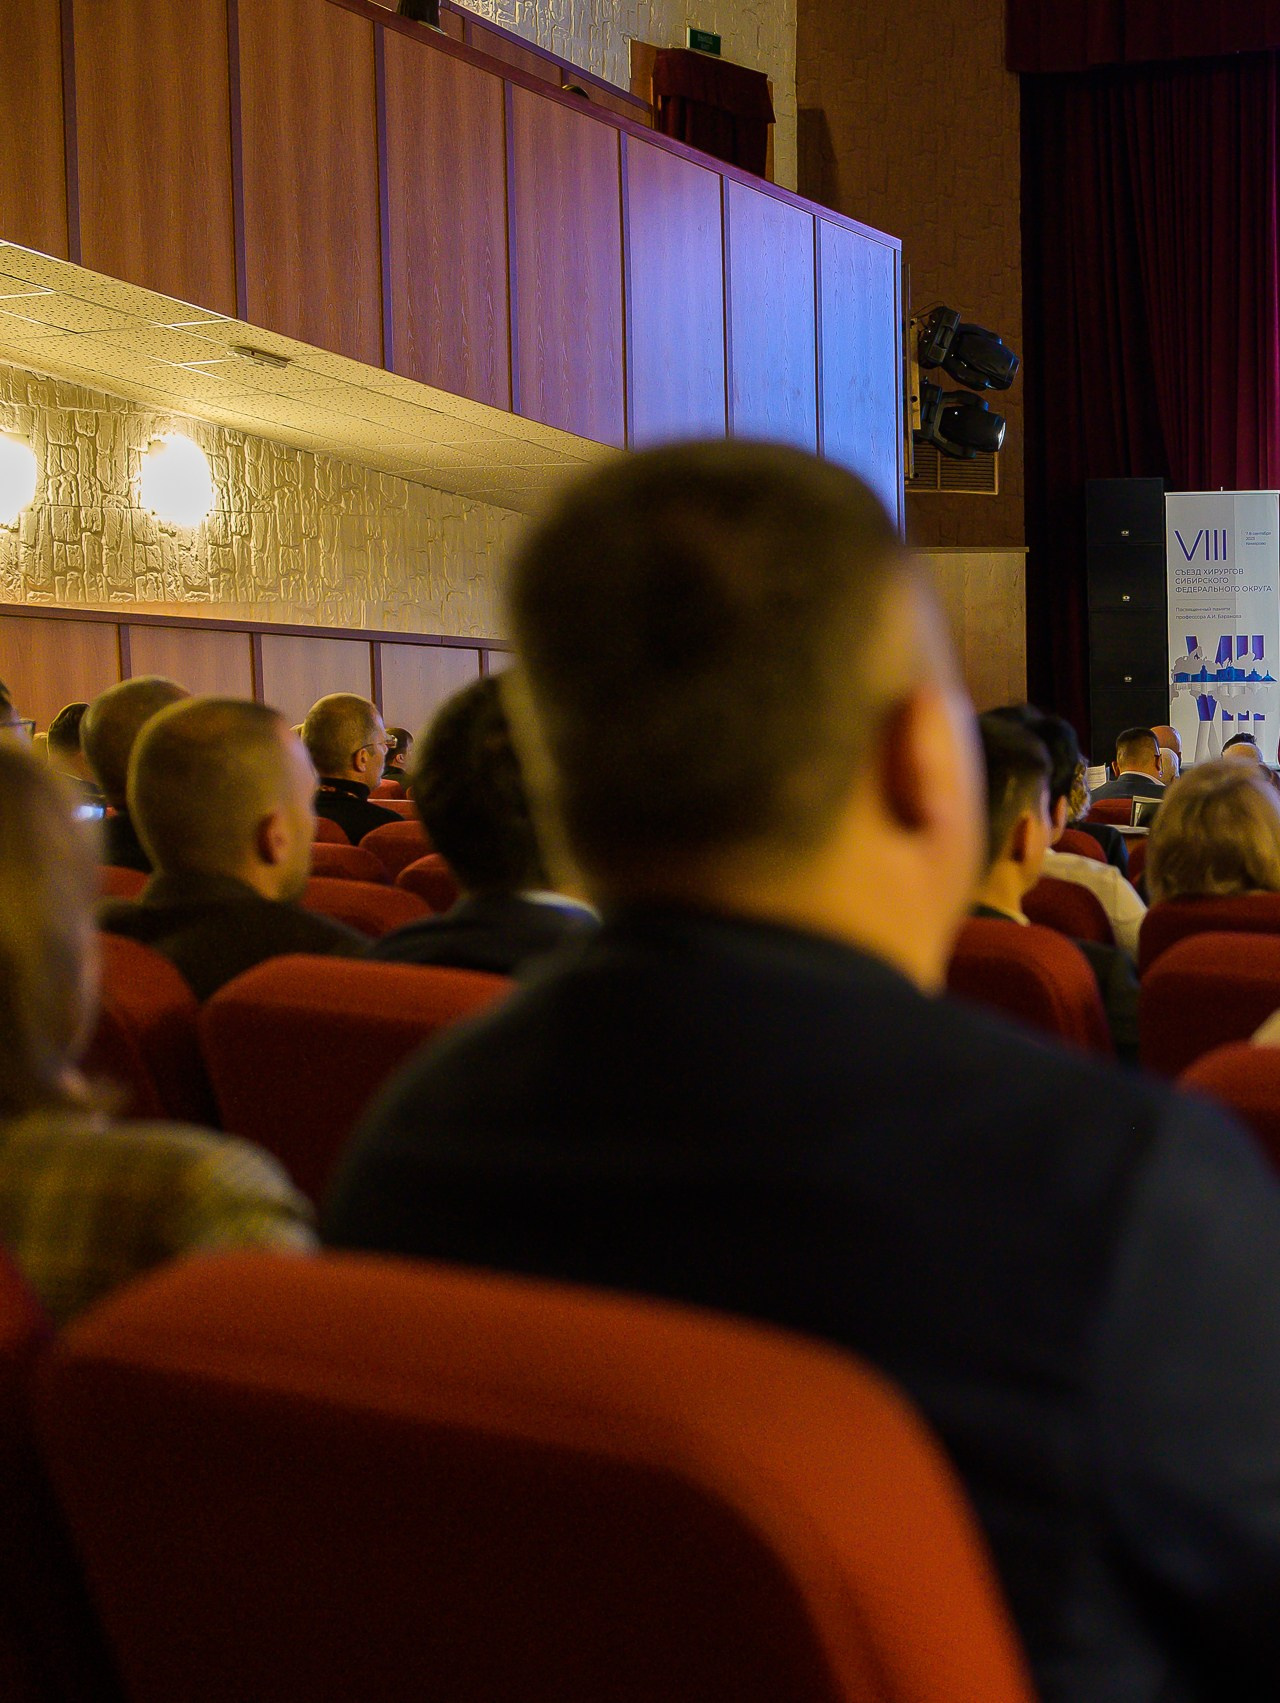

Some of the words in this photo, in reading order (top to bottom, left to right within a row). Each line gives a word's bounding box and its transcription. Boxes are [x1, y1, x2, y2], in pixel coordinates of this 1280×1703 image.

[1174, 530, 1227, 561] VIII
[1175, 568, 1201, 576] СЪЕЗД
[1175, 577, 1229, 585] СИБИРСКОГО
